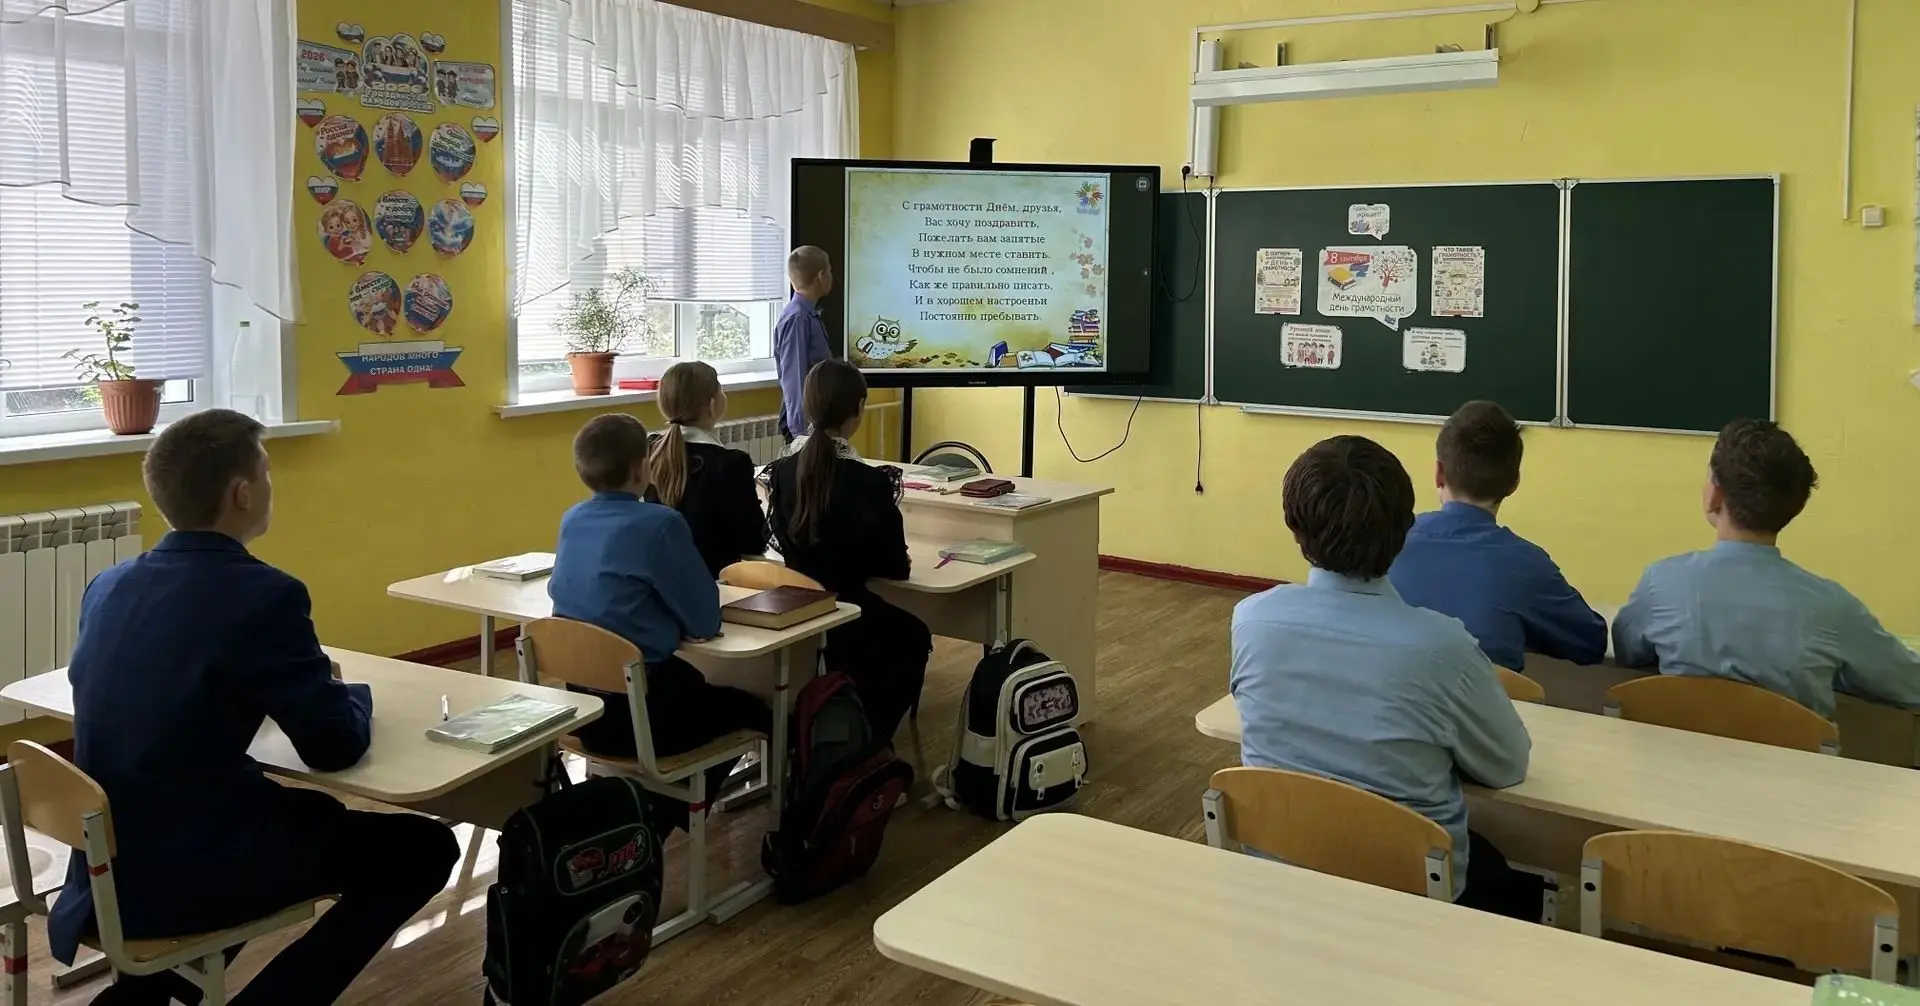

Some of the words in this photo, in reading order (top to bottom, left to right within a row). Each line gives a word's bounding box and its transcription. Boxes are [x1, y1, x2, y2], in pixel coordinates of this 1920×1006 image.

[301, 49, 325, 62] 2026
[902, 201, 910, 210] С
[913, 203, 982, 213] грамотности
[1022, 204, 1062, 214] друзья,
[924, 216, 943, 227] Вас
[946, 219, 971, 228] хочу
[974, 219, 1040, 229] поздравить,
[918, 232, 974, 243] Пожелать
[977, 235, 997, 243] вам
[1000, 235, 1046, 244] запятые
[912, 248, 919, 258] В
[924, 250, 965, 260] нужном
[969, 250, 1001, 259] месте
[1004, 250, 1051, 260] ставить.
[1330, 252, 1338, 264] 8
[1340, 255, 1368, 263] сентября
[908, 264, 944, 274] Чтобы
[947, 266, 960, 274] не
[963, 264, 993, 275] было
[995, 265, 1048, 275] сомнений
[909, 279, 930, 290] Как
[934, 281, 948, 290] же
[952, 281, 1010, 291] правильно
[914, 295, 923, 305] И
[927, 297, 934, 305] в
[937, 297, 983, 307] хорошем
[987, 297, 1048, 307] настроеньи
[1332, 293, 1401, 306] Международный
[1329, 304, 1349, 313] день
[1351, 304, 1405, 314] грамотности
[920, 311, 977, 321] Постоянно
[362, 352, 406, 363] НАРОДОВ
[407, 351, 439, 361] МНОГО
[370, 365, 405, 376] СТРАНА
[407, 364, 433, 374] ОДНА!
